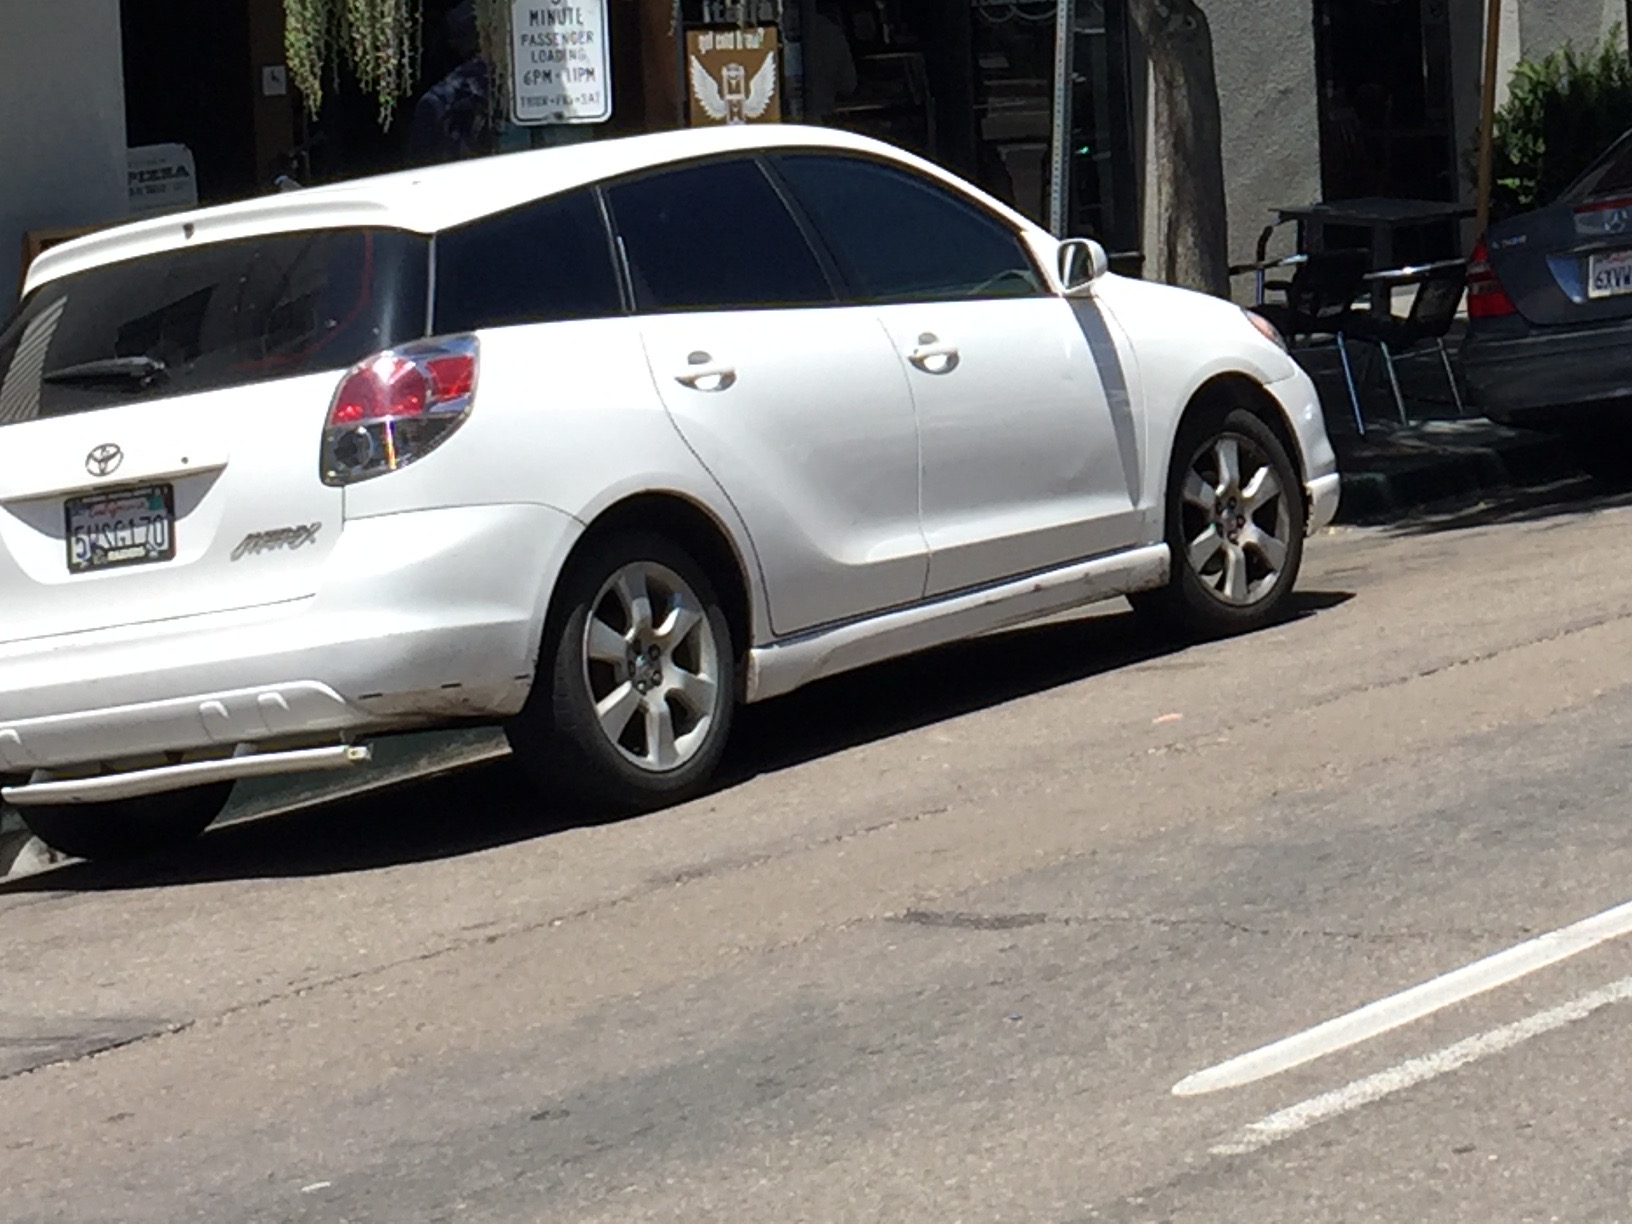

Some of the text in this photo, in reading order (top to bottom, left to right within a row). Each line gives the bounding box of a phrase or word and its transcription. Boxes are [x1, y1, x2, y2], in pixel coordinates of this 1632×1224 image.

[529, 7, 584, 26] MINUTE
[520, 31, 594, 46] PASSENGER
[531, 49, 587, 63] LOADING
